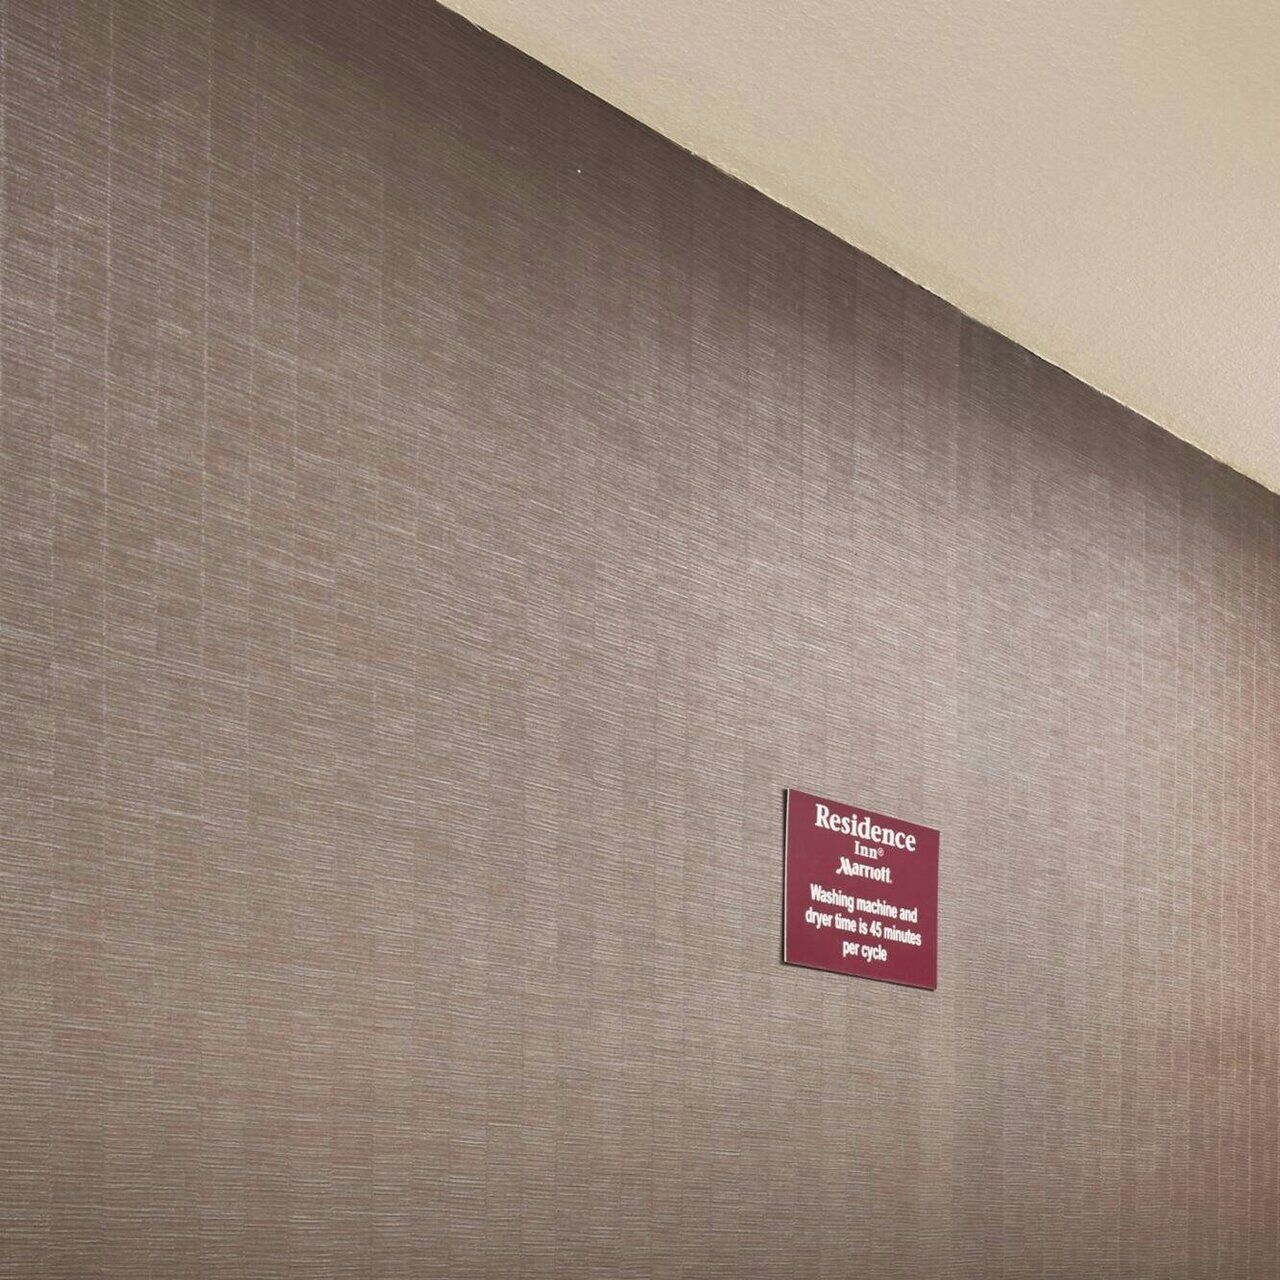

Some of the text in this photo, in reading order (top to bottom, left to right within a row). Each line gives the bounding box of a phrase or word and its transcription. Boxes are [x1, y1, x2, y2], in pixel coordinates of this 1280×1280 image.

[815, 803, 916, 852] Residence
[836, 856, 892, 883] Marriott
[810, 883, 918, 923] Washing machine and
[805, 906, 922, 946] dryer time is 45 minutes
[842, 941, 888, 962] per cycle
